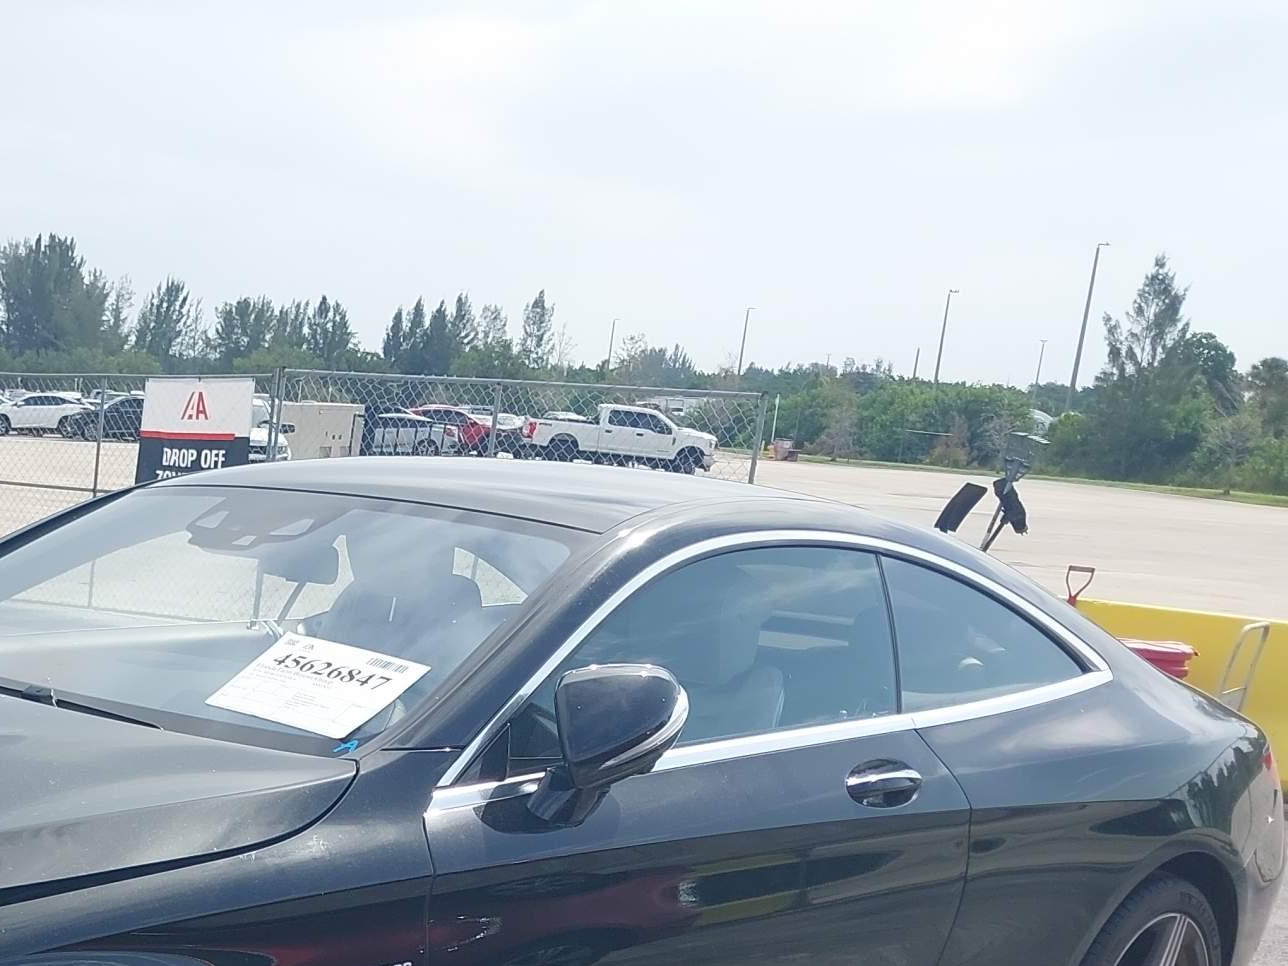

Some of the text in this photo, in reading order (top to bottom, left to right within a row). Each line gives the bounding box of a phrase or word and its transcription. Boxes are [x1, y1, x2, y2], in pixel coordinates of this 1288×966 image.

[162, 447, 226, 469] DROP OFF
[273, 653, 392, 690] 45626847
